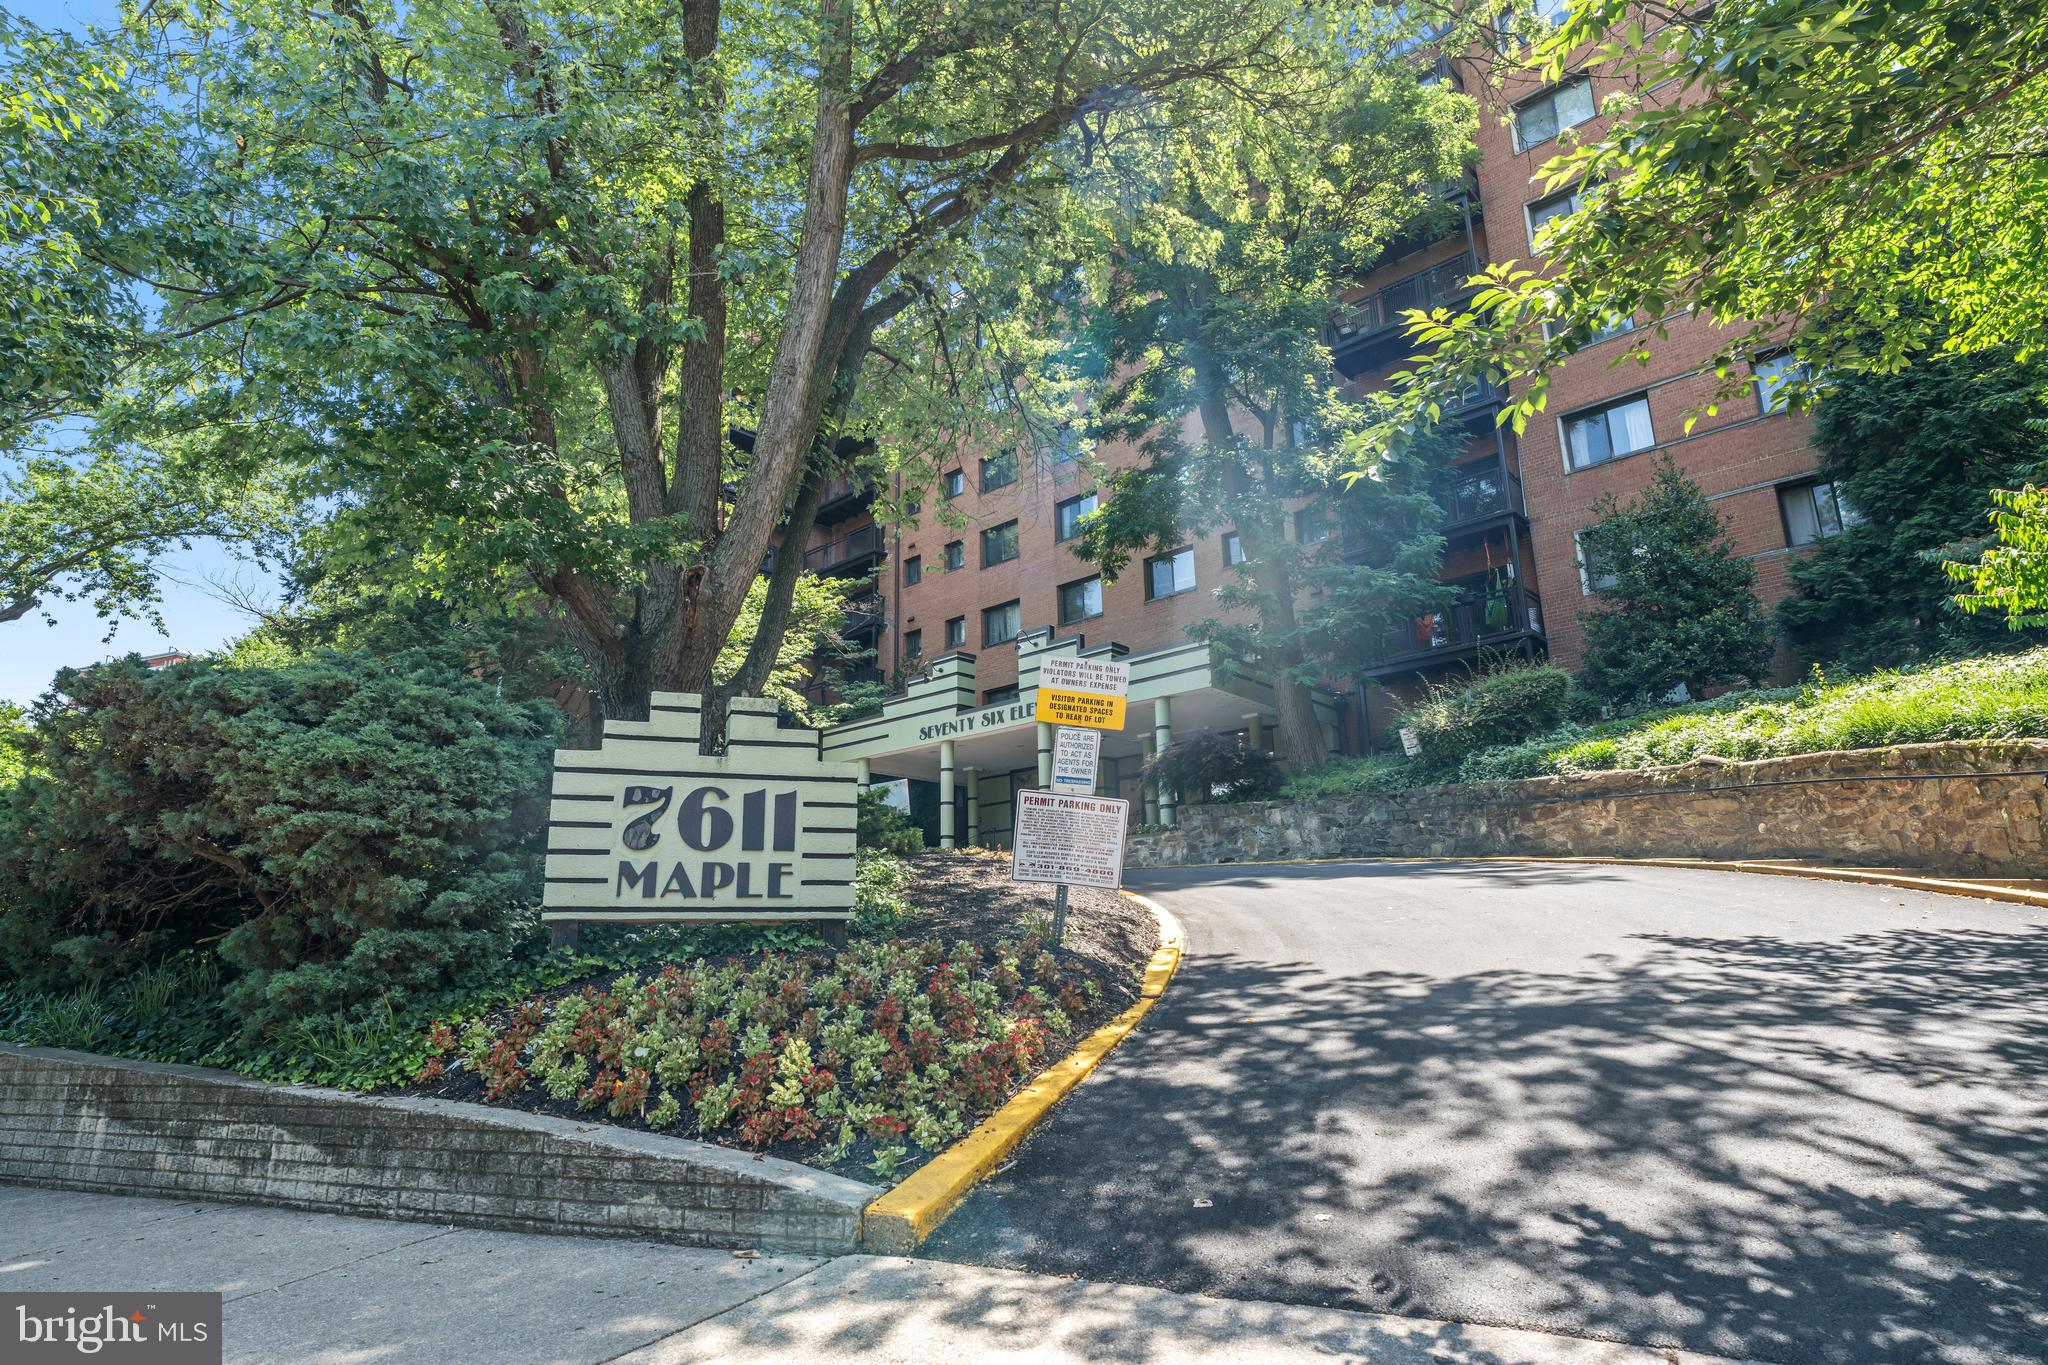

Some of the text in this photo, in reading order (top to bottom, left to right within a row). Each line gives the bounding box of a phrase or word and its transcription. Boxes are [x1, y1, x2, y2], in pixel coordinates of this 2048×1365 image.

[1051, 660, 1073, 669] PERMIT
[1076, 662, 1102, 672] PARKING
[1043, 668, 1076, 677] VIOLATORS
[1061, 678, 1087, 687] OWNERS
[1090, 681, 1117, 690] EXPENSE
[1052, 695, 1075, 703] VISITOR
[1078, 697, 1104, 706] PARKING
[1050, 703, 1113, 716] DESIGNATED SPACES
[919, 702, 1037, 740] SEVENTY SIX ELE
[1060, 742, 1094, 750] AUTHORIZED
[1024, 796, 1121, 814] PERMIT PARKING ONLY
[622, 785, 797, 852] 7611
[616, 860, 794, 898] MAPLE
